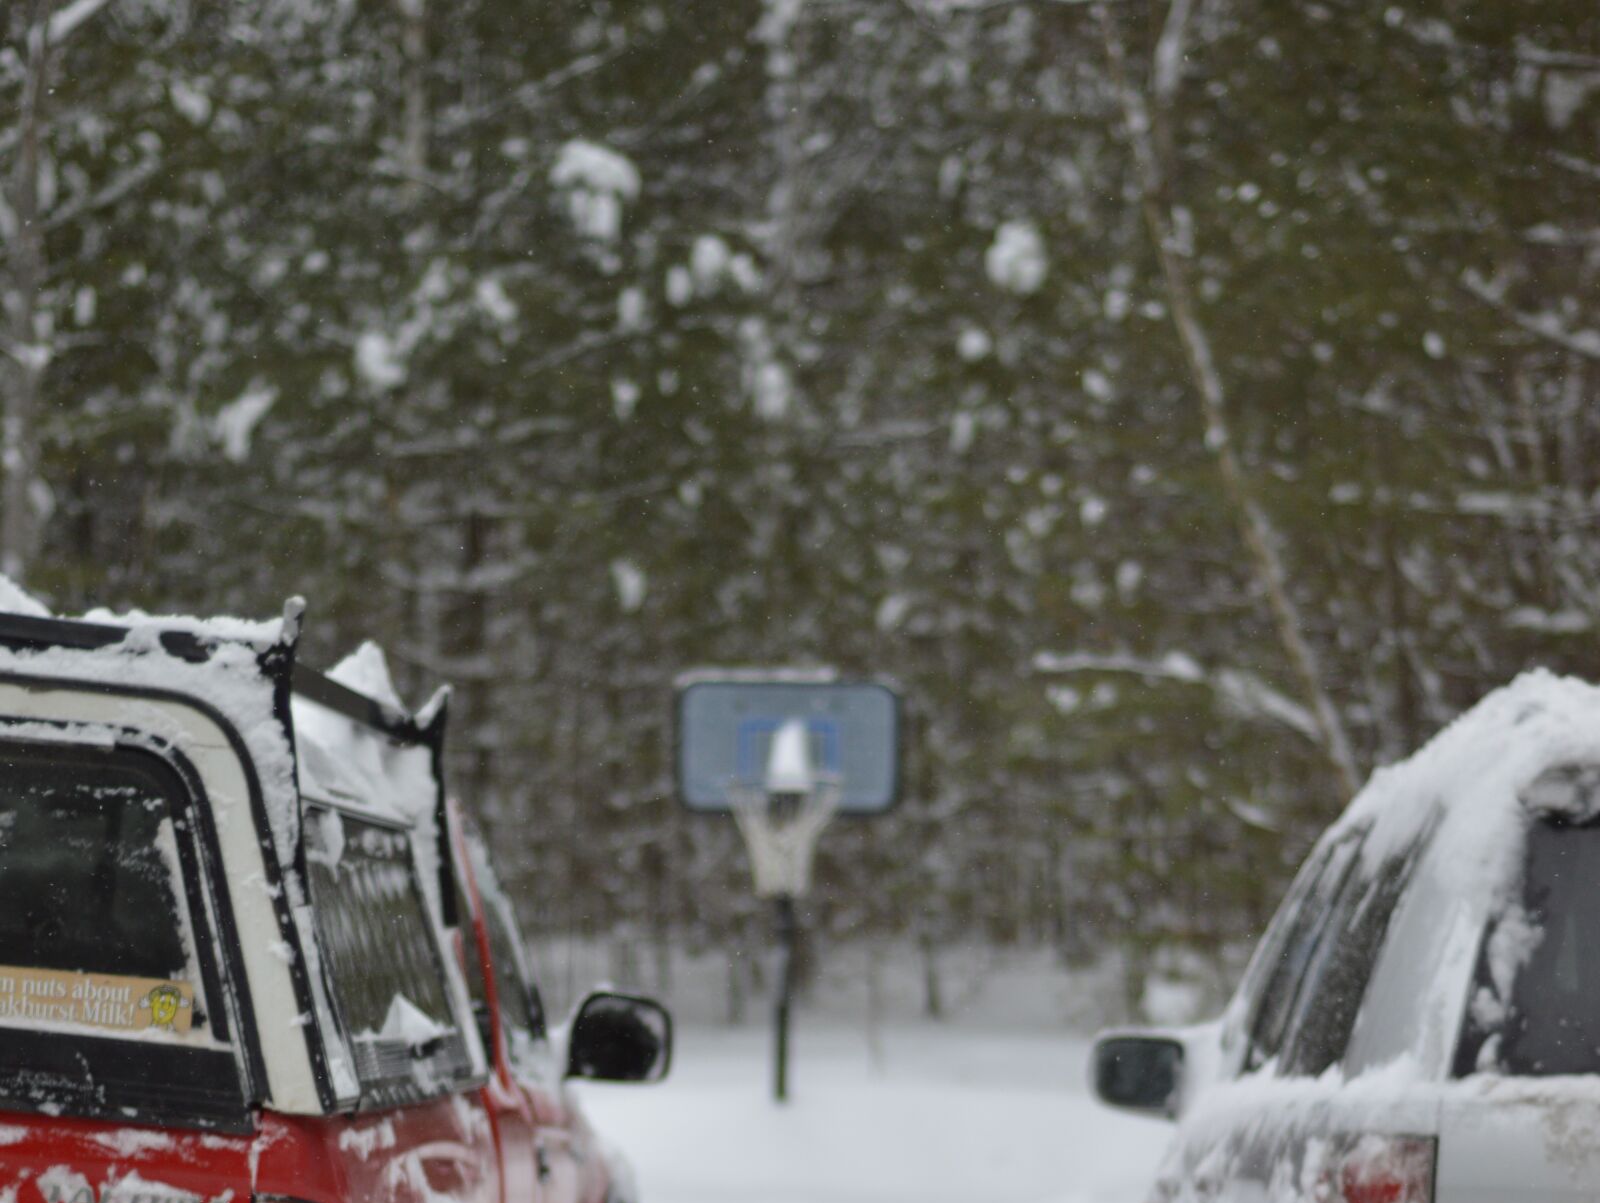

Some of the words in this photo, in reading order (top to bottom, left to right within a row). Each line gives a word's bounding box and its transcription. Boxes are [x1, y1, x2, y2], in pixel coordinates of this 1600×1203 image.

[23, 978, 66, 997] nuts
[72, 978, 131, 1002] about
[0, 992, 77, 1021] akhurst
[82, 1000, 135, 1026] Milk!
